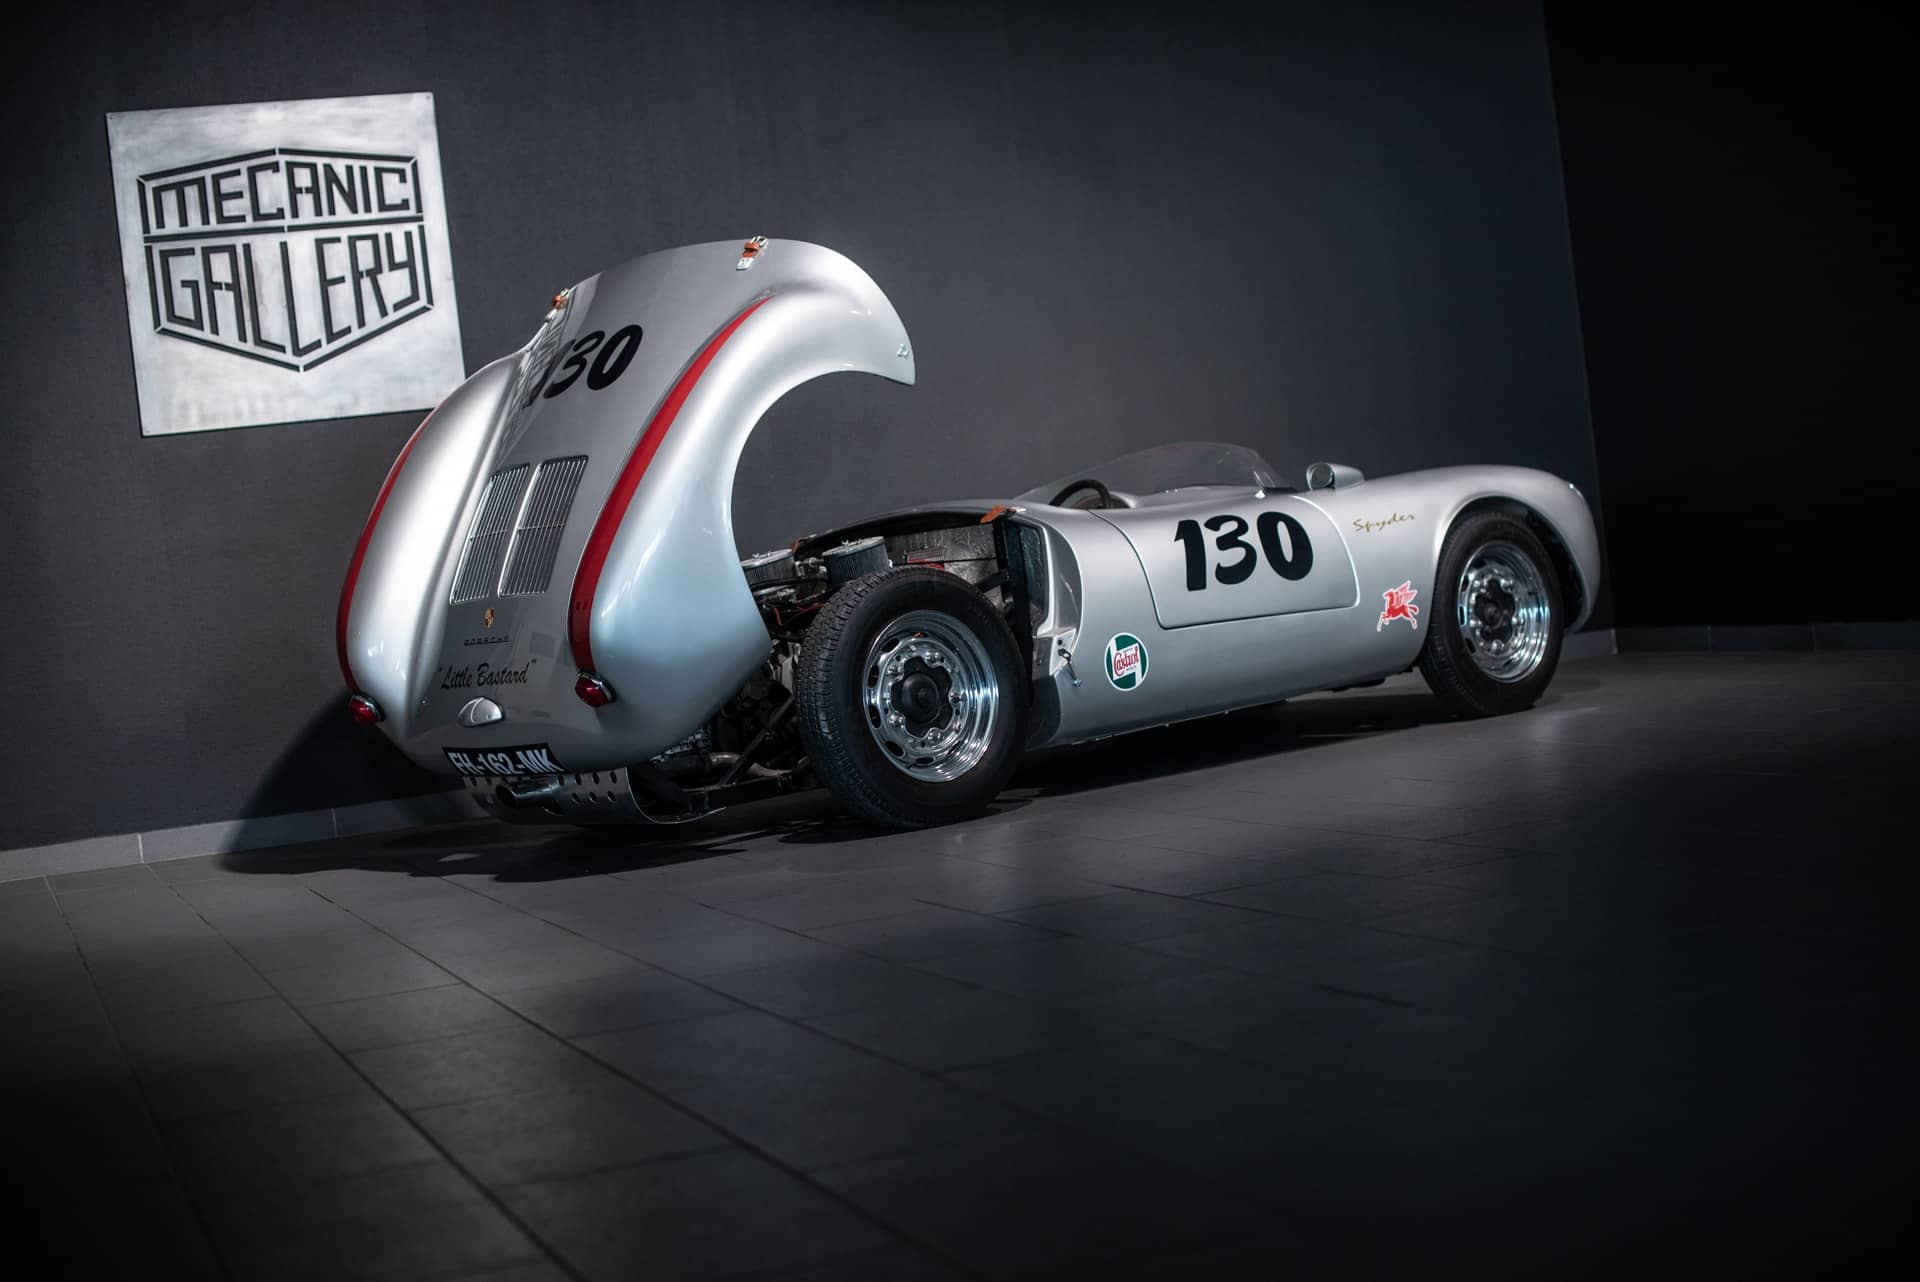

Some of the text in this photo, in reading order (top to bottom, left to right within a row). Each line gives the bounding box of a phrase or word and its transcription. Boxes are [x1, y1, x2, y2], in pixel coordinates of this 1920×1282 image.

[152, 160, 411, 229] MECANIC
[158, 230, 421, 358] GALLERY
[522, 324, 643, 409] 130
[1174, 511, 1313, 591] 130
[1352, 512, 1416, 533] Spyder
[1113, 645, 1139, 677] Castrol
